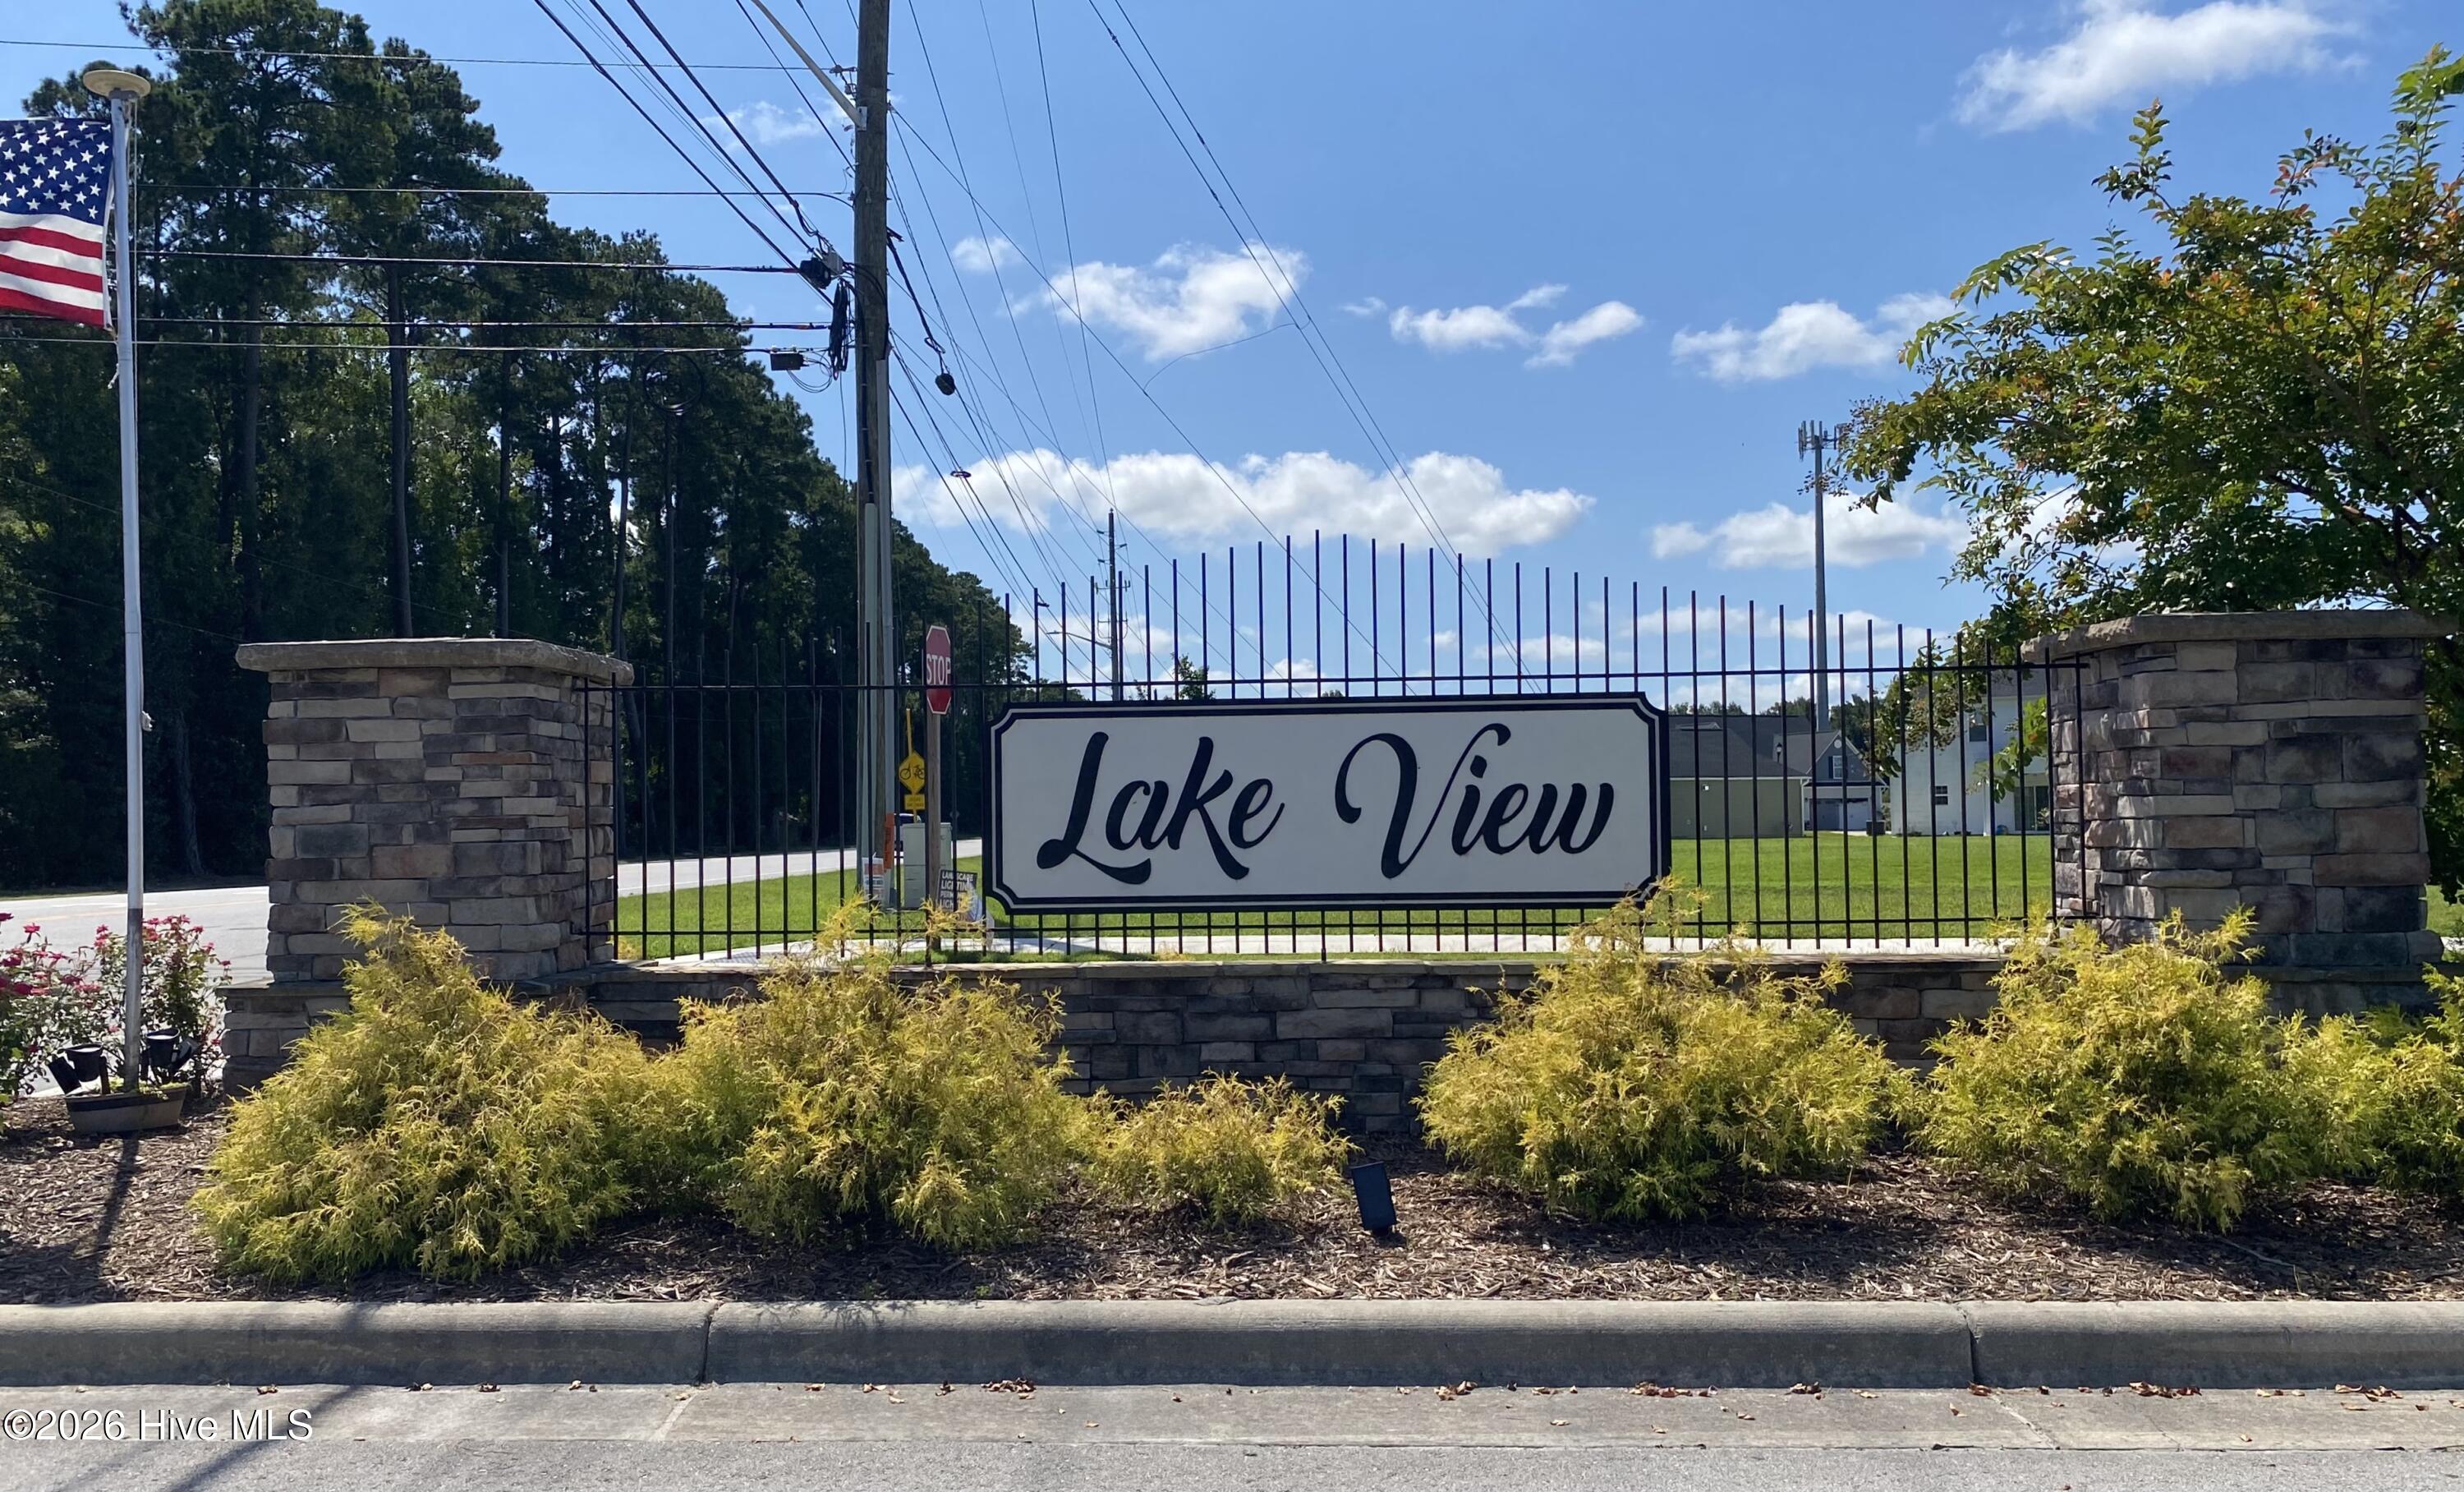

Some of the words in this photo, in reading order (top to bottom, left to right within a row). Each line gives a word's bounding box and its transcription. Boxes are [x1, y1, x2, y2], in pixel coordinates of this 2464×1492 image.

[926, 653, 951, 685] STOP
[1037, 731, 1285, 885] Lake
[1335, 723, 1614, 879] View
[941, 871, 974, 882] LANSCAPE
